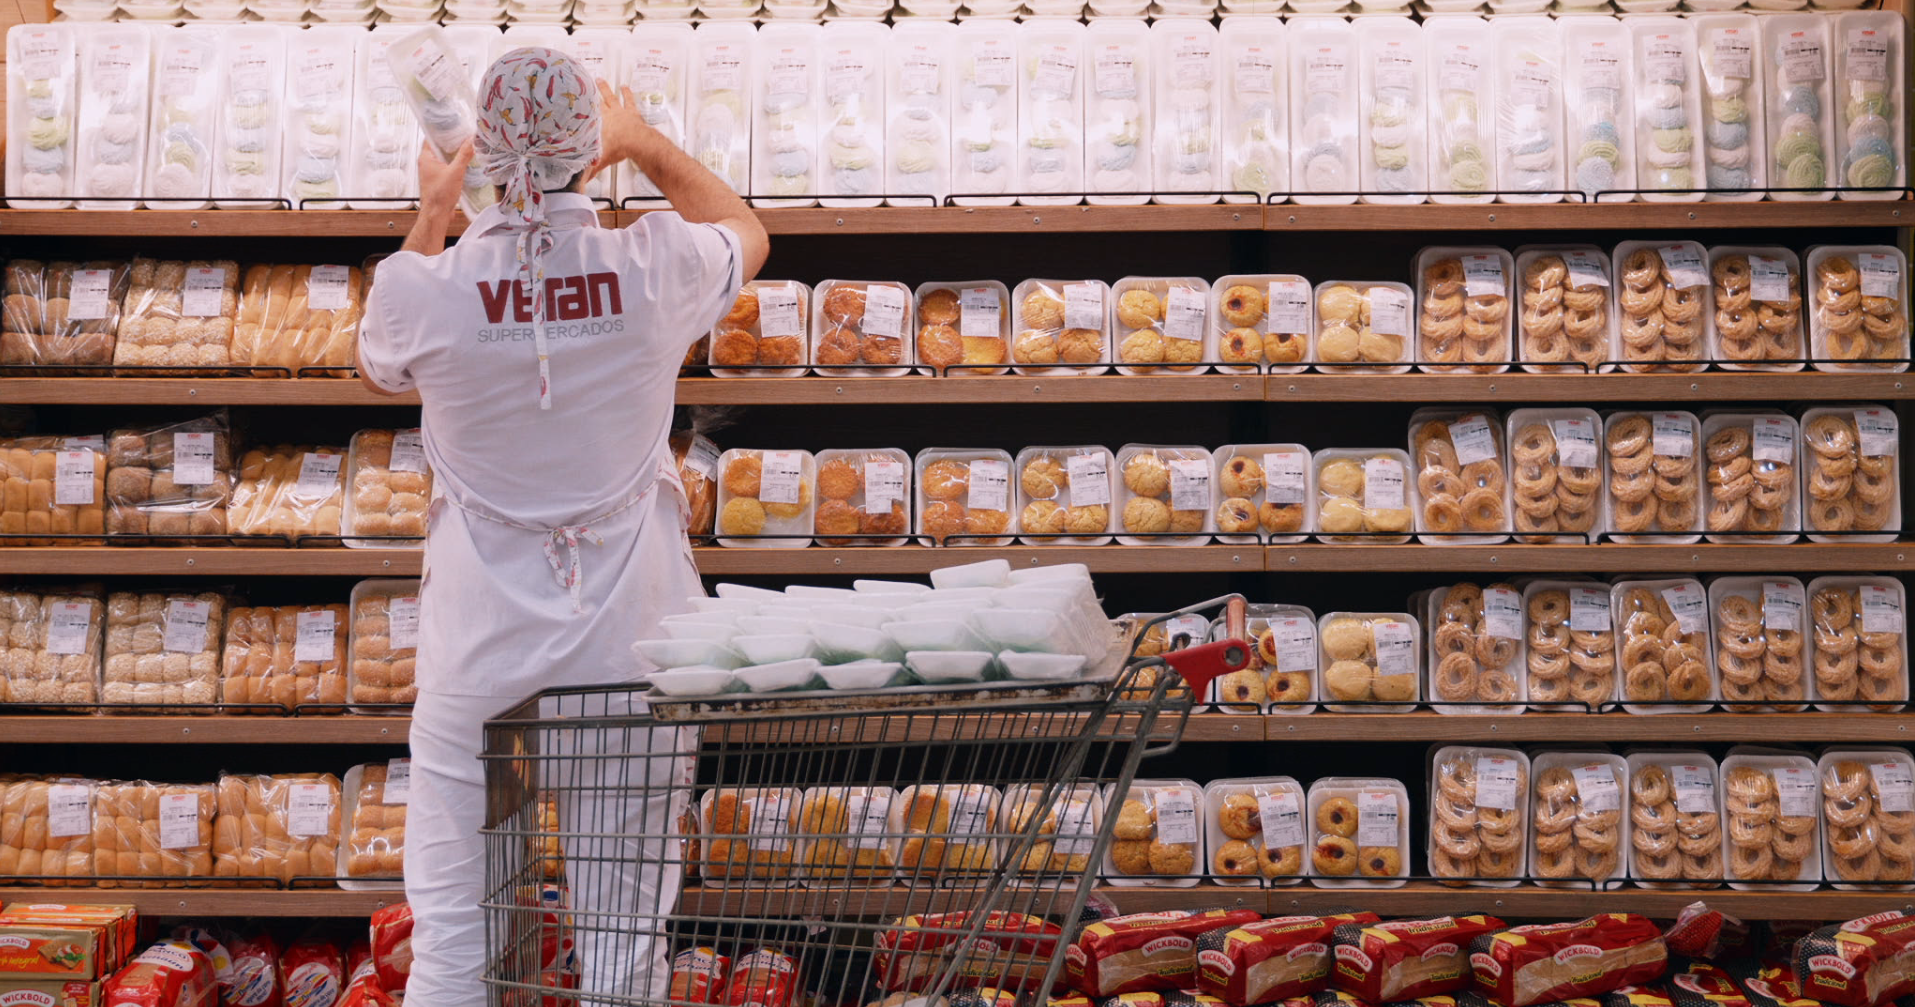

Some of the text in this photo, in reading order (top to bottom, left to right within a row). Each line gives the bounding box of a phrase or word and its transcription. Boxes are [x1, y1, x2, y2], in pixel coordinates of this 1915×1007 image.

[476, 271, 622, 324] veran
[477, 319, 624, 342] SUPERERCADOS
[1145, 939, 1189, 954] WICKBOLD
[1557, 946, 1600, 961] WICKBOLD
[1201, 953, 1232, 971] WICKBOLD
[1336, 948, 1370, 967] WICKBOLD
[1811, 957, 1851, 975] WICKBOLD
[1814, 974, 1847, 989] Tradicional
[3, 993, 51, 1004] WICKBOLD
